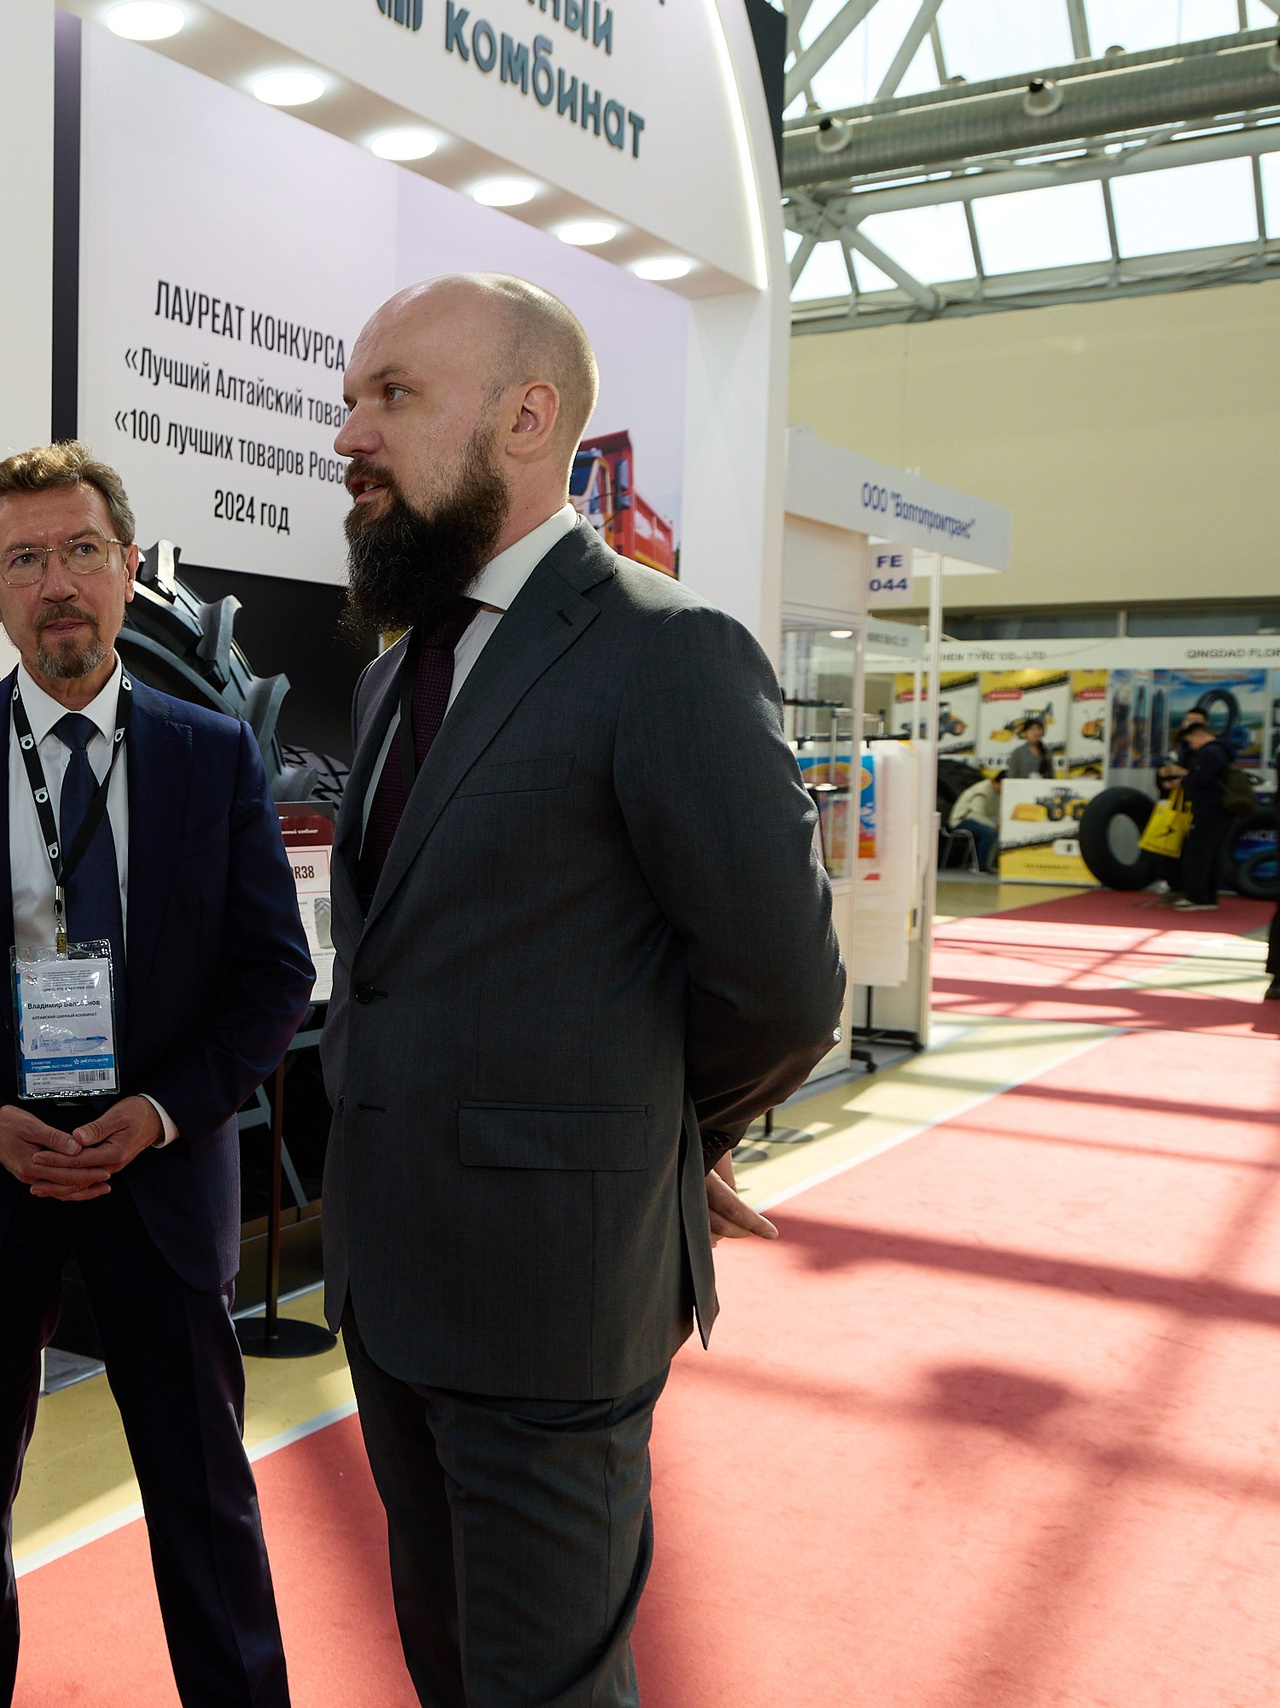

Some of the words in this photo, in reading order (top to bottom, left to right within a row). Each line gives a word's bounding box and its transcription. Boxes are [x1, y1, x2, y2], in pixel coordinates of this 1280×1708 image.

[445, 0, 645, 158] комбинат
[155, 280, 245, 341] ЛАУРЕАТ
[251, 310, 346, 372] КОНКУРСА
[124, 347, 210, 395] «Лучший
[216, 368, 303, 418] Алтайский
[115, 409, 161, 445] «100
[167, 422, 233, 461] лучших
[239, 438, 303, 476] товаров
[309, 450, 347, 484] Росс
[215, 489, 255, 524] 2024
[261, 502, 291, 535] год
[862, 482, 888, 513] ООО
[877, 554, 903, 568] FE
[869, 578, 908, 592] 044
[1187, 648, 1246, 660] QINGDAO
[291, 865, 315, 880] R38
[27, 1001, 62, 1011] Владимир
